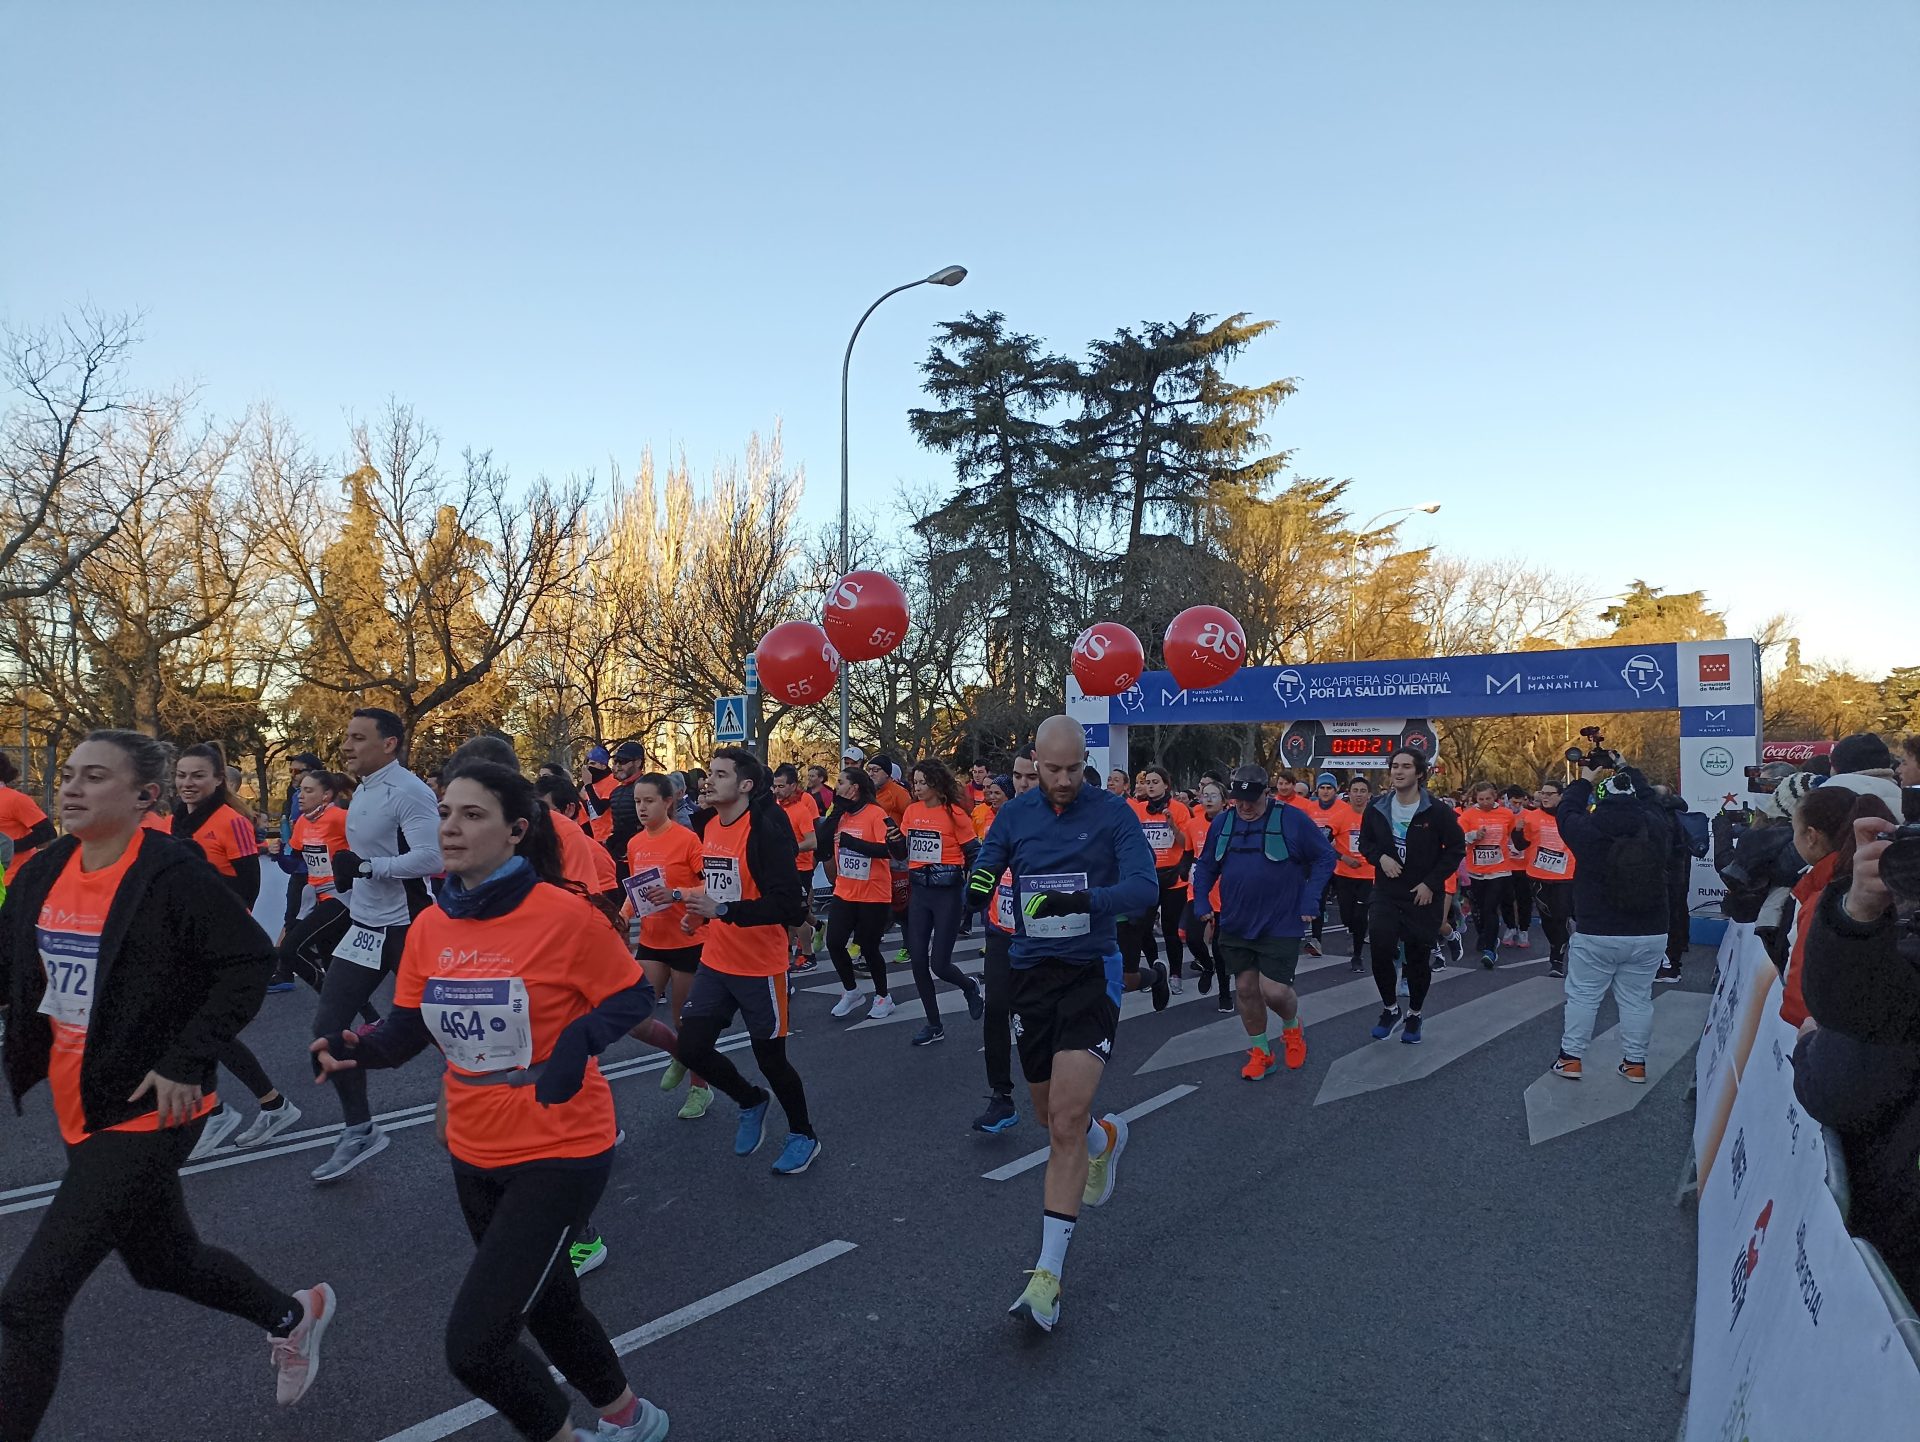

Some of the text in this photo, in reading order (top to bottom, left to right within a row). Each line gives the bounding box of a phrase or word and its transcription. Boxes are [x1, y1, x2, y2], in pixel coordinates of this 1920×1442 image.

[868, 627, 896, 648] 55
[1072, 627, 1111, 661] as
[1197, 622, 1242, 661] as
[1323, 675, 1381, 687] CARRERA
[1384, 672, 1452, 685] SOLIDARIA
[1527, 680, 1600, 691] MANANTIAL
[1310, 683, 1452, 699] POR LA SALUD MENTAL
[1192, 695, 1244, 704] MANANTIAL
[1332, 738, 1394, 753] 0:00:21
[1762, 744, 1816, 760] Coca-Cola
[912, 839, 934, 853] 2032
[1477, 850, 1495, 859] 2313
[1538, 853, 1557, 866] 2677
[843, 857, 860, 870] 858
[352, 930, 375, 952] 892
[47, 960, 88, 997] 372
[512, 998, 523, 1014] 464
[440, 1010, 486, 1041] 464
